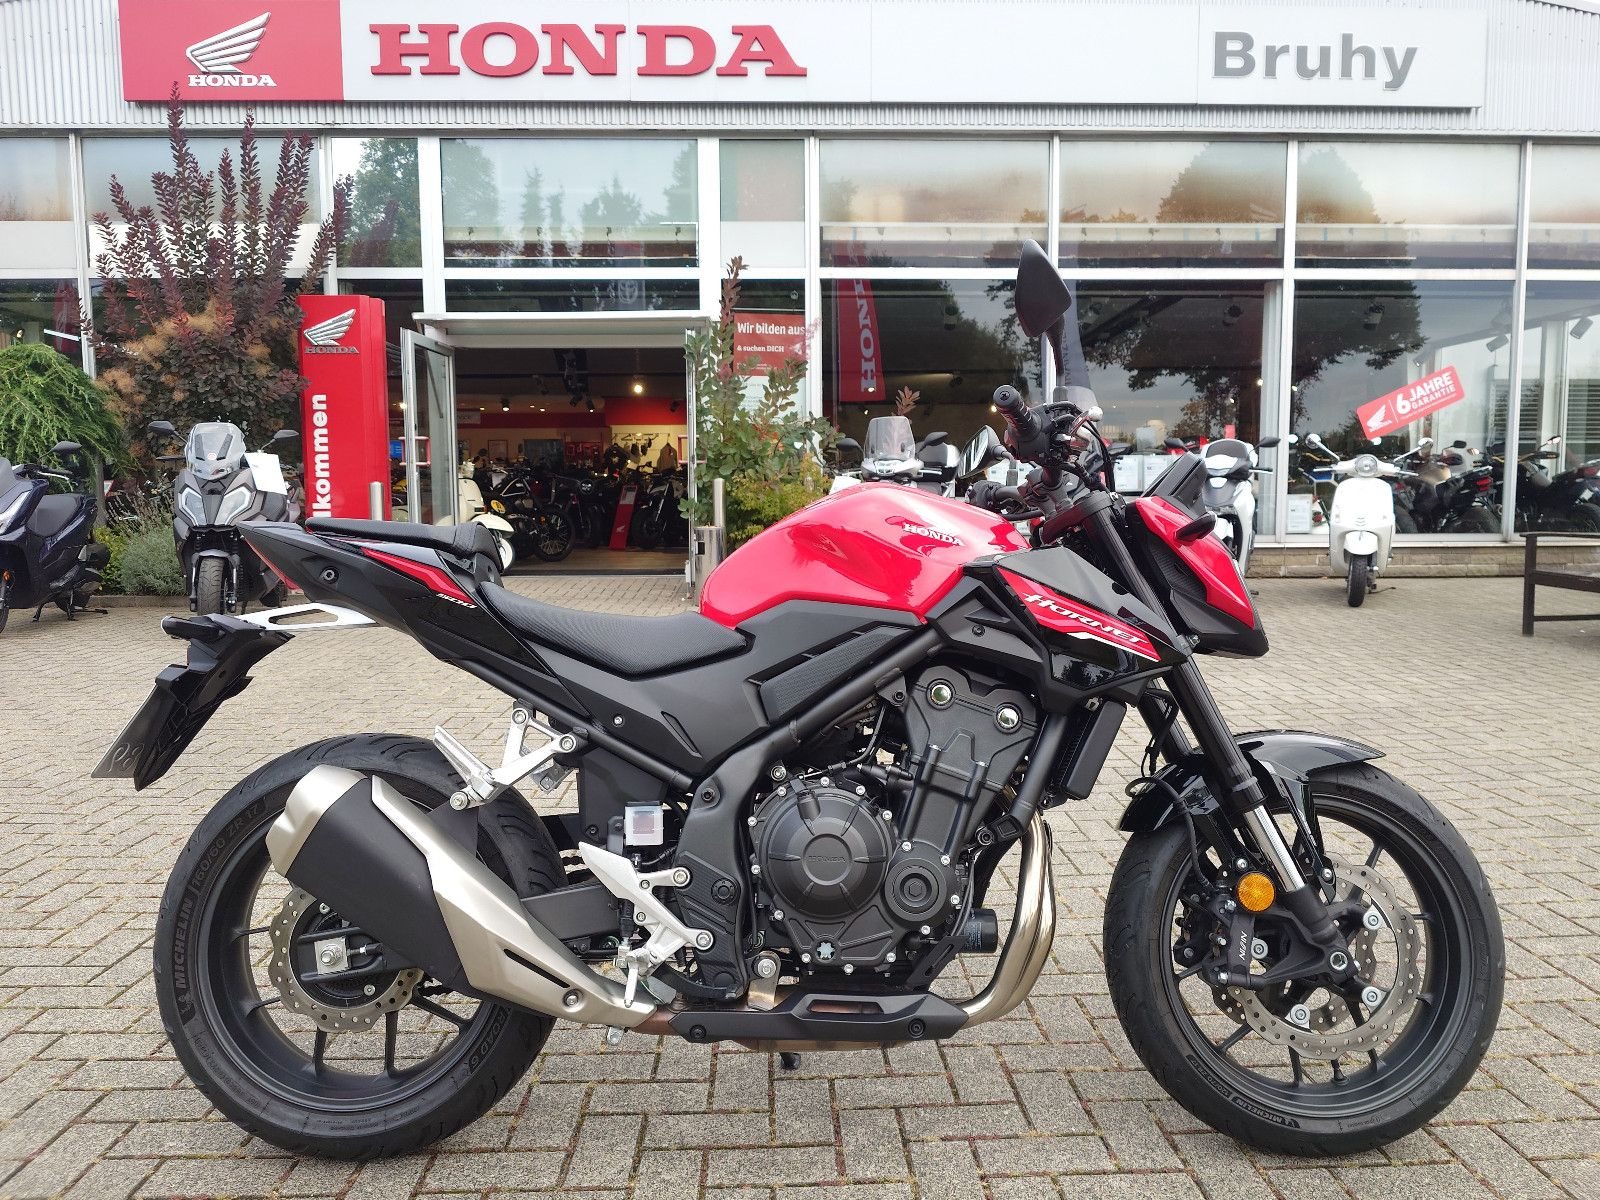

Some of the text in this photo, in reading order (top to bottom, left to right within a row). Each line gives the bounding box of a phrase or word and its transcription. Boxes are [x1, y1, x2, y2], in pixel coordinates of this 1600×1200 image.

[369, 22, 807, 77] HONDA
[1212, 31, 1418, 91] Bruhy
[188, 74, 277, 87] HONDA
[737, 322, 806, 336] Wir bilden aus
[304, 346, 360, 354] HONDA
[767, 345, 785, 353] DICH
[1396, 393, 1411, 414] 6
[1409, 371, 1453, 402] JAHRE
[1411, 384, 1456, 410] GARANTIE
[902, 521, 966, 547] HONDA
[174, 899, 194, 990] MICHELIN
[1235, 1098, 1283, 1124] MICHELIN
